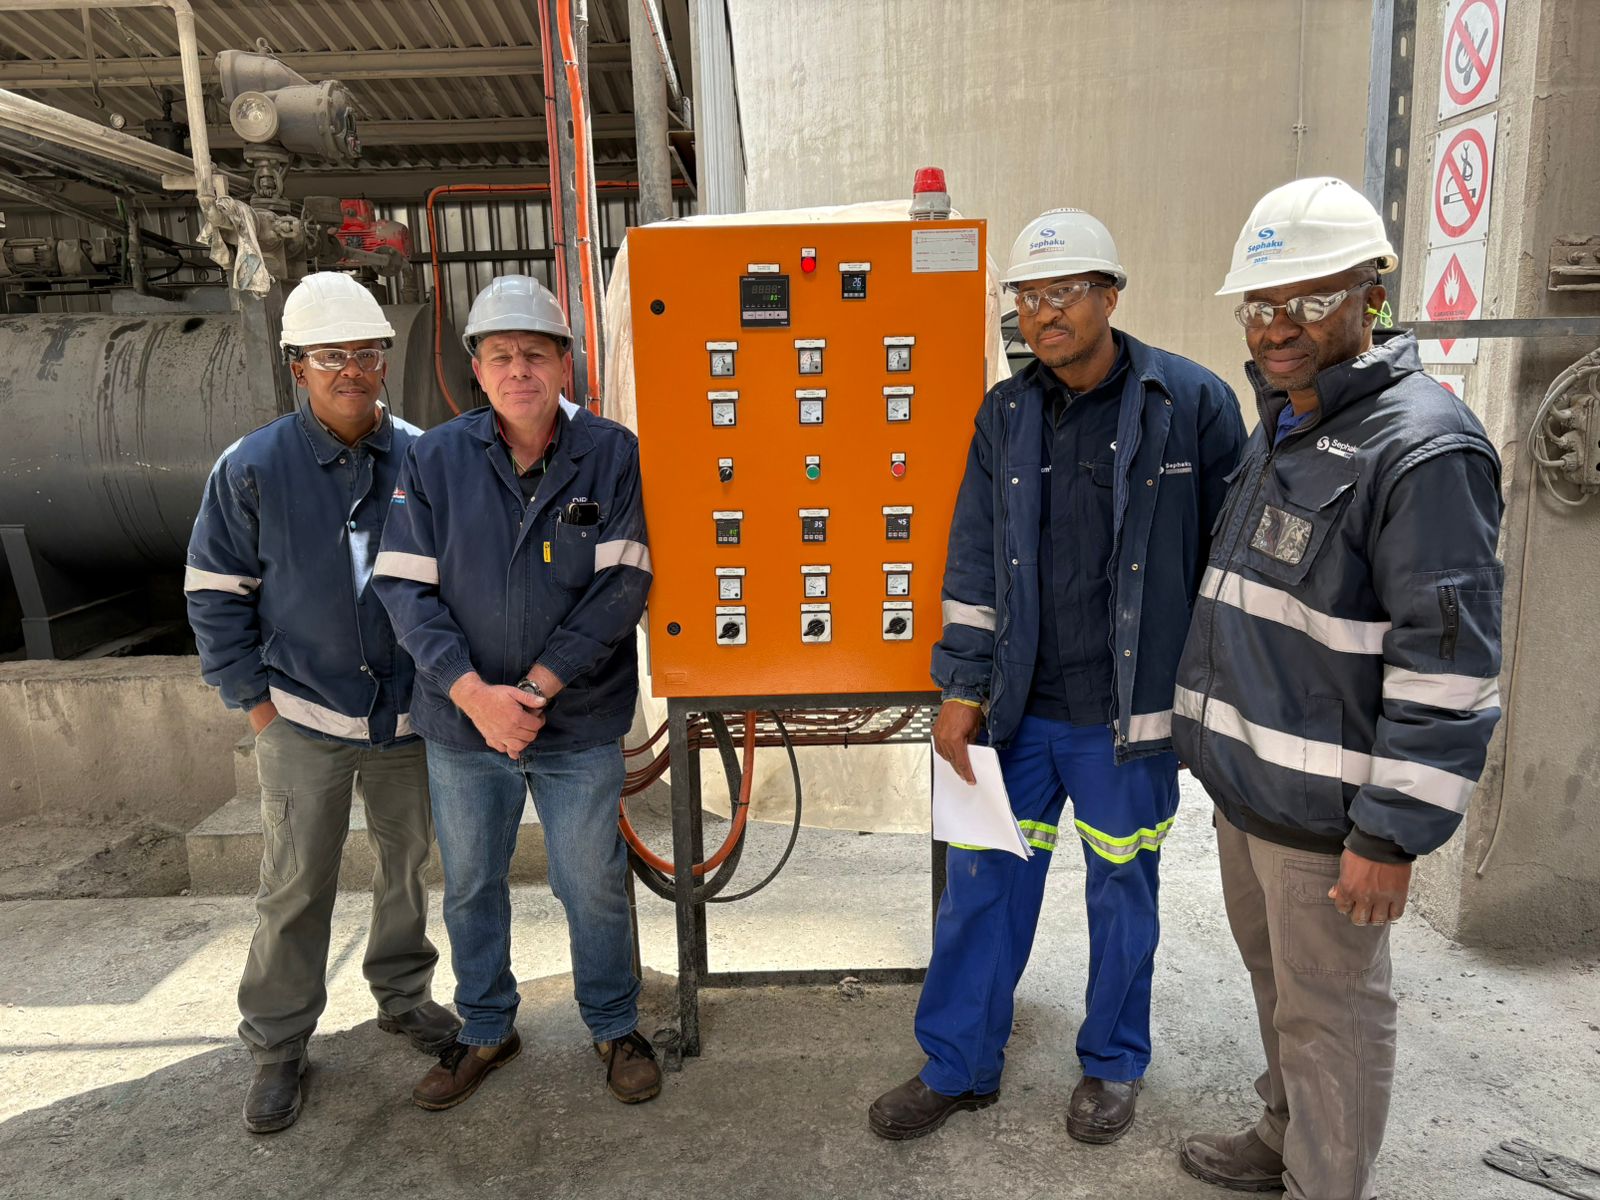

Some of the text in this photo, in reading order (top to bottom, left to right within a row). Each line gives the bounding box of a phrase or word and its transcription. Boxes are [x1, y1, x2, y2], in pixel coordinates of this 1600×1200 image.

[1029, 238, 1065, 249] Sephaku
[1247, 240, 1283, 253] Sephaku
[1331, 439, 1358, 453] Sephak
